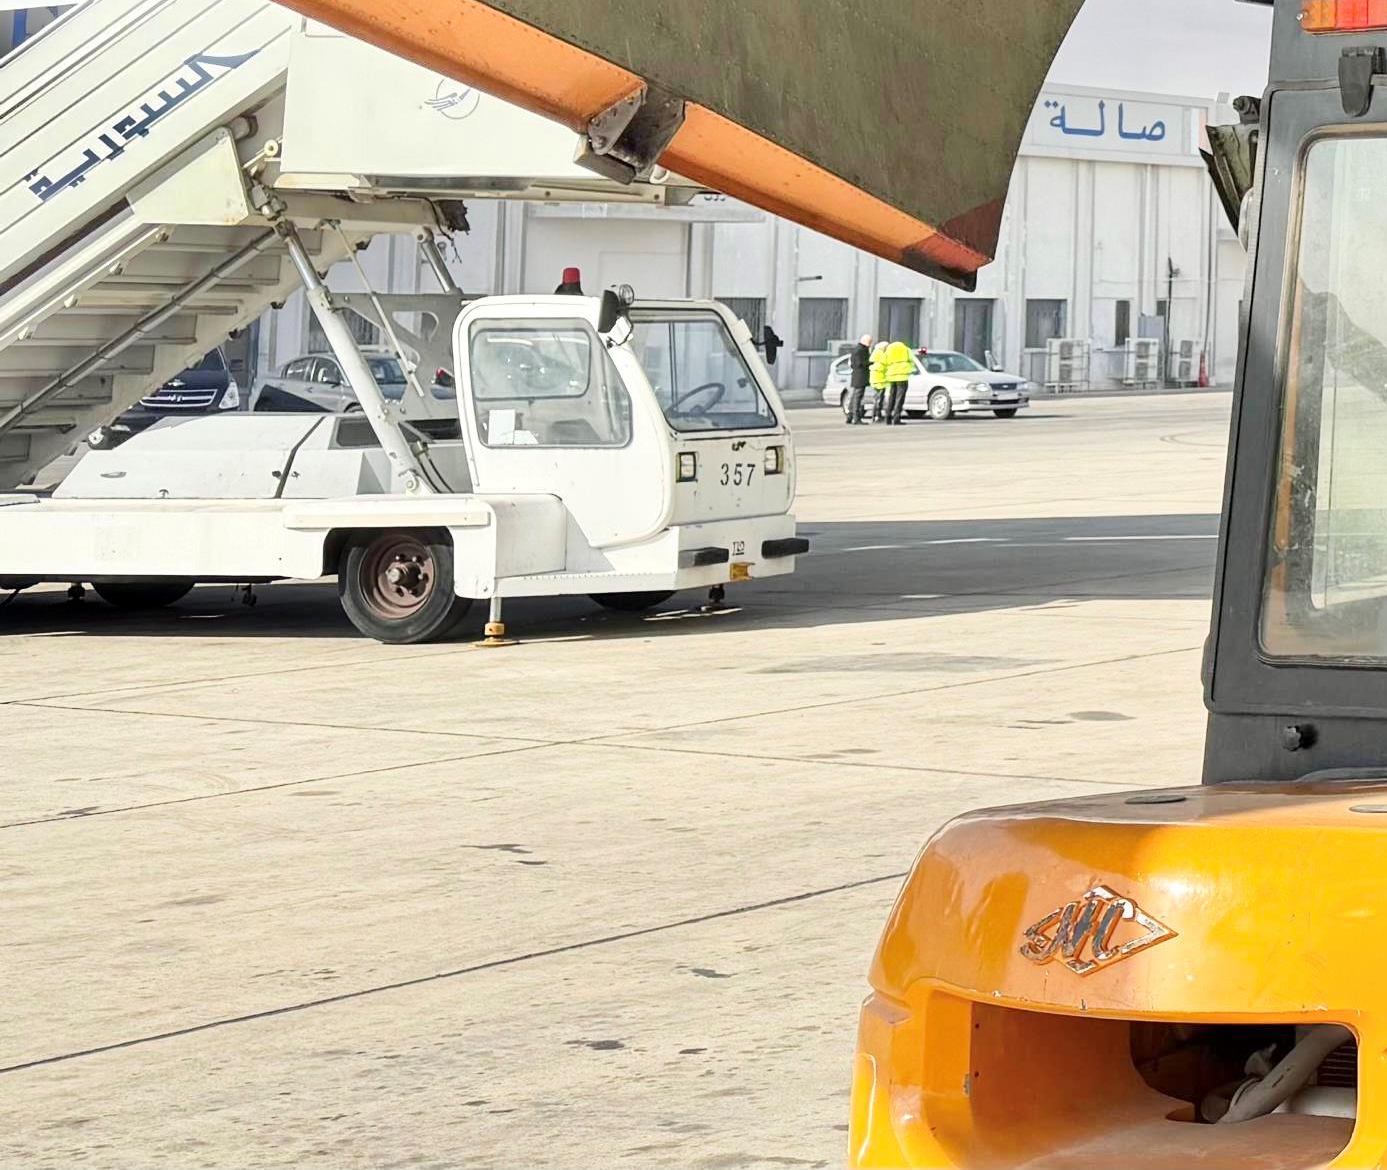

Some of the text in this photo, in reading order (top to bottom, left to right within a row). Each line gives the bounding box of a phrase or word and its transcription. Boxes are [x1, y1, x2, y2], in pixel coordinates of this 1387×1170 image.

[24, 48, 262, 202] السورية
[1043, 99, 1166, 142] صالة
[719, 462, 757, 487] 357
